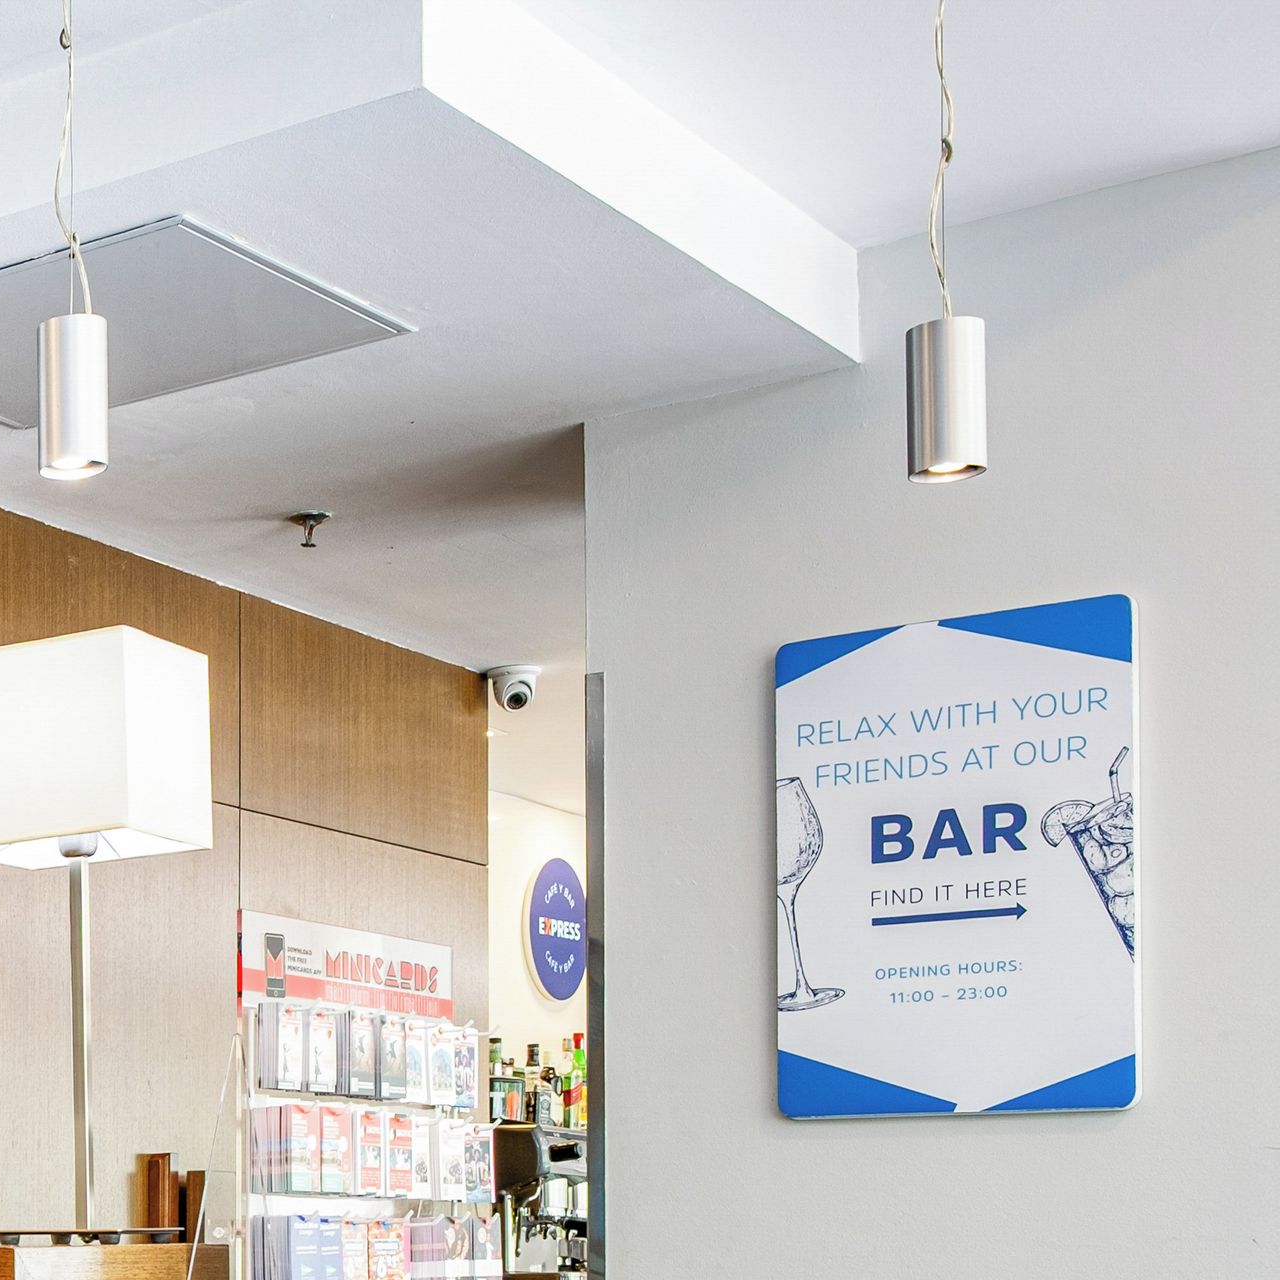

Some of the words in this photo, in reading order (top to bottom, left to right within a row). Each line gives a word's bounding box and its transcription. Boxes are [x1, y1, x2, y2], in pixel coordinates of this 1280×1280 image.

[796, 711, 898, 748] RELAX
[909, 699, 998, 734] WITH
[1011, 686, 1109, 721] YOUR
[814, 750, 948, 789] FRIENDS
[960, 744, 1000, 773] AT
[1012, 735, 1088, 767] OUR
[870, 802, 1029, 865] BAR
[559, 883, 564, 894] Y
[563, 887, 576, 909] BAR
[870, 885, 924, 908] FIND
[934, 883, 954, 903] IT
[964, 877, 1028, 900] HERE
[538, 916, 581, 941] EXPRESS
[325, 949, 439, 994] MINICARDS
[558, 964, 563, 974] Y
[563, 953, 575, 973] BAR
[874, 961, 952, 982] OPENING
[957, 958, 1024, 977] HOURS:
[889, 987, 934, 1004] 11:00
[956, 985, 1008, 1002] 23:00
